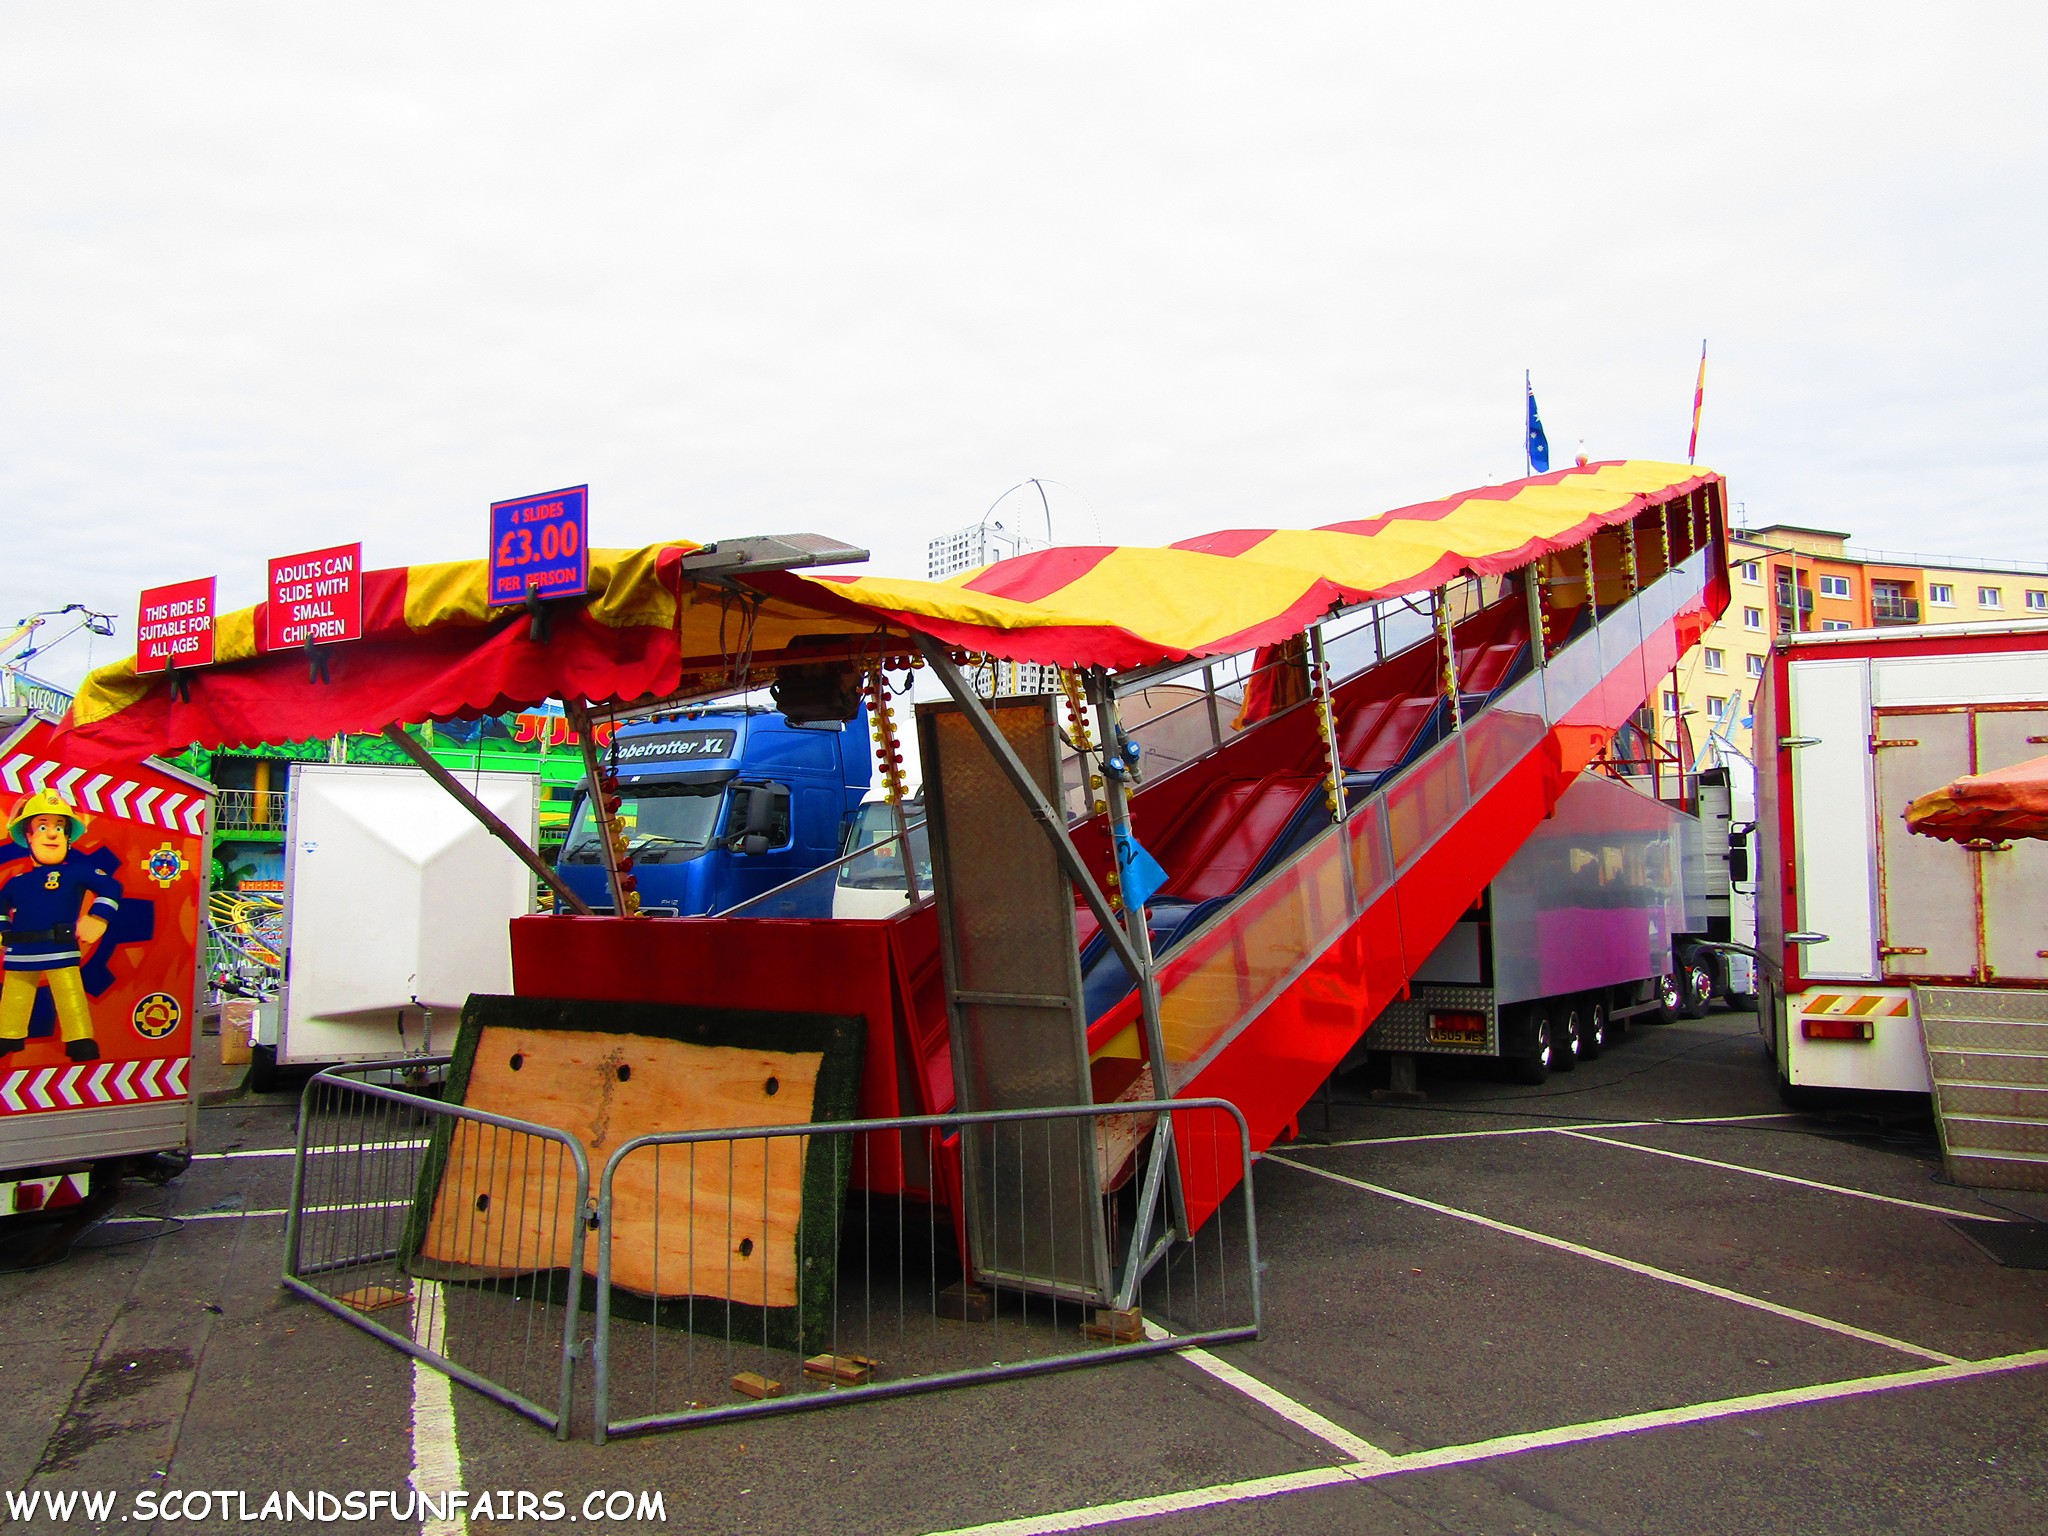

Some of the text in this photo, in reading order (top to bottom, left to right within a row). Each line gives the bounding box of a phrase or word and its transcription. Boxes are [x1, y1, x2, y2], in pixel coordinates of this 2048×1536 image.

[511, 501, 564, 524] 4 SLIDES
[497, 520, 578, 567] £3.00
[275, 555, 353, 584] ADULTS CAN
[498, 567, 577, 592] PER PERSON
[279, 577, 349, 604] SLIDE WITH
[146, 597, 206, 622] THIS RIDE IS
[293, 600, 334, 622] SMALL
[140, 615, 211, 641] SUITABLE FOR
[282, 619, 345, 643] CHILDREN
[150, 636, 199, 658] ALL AGES
[698, 738, 724, 754] XL
